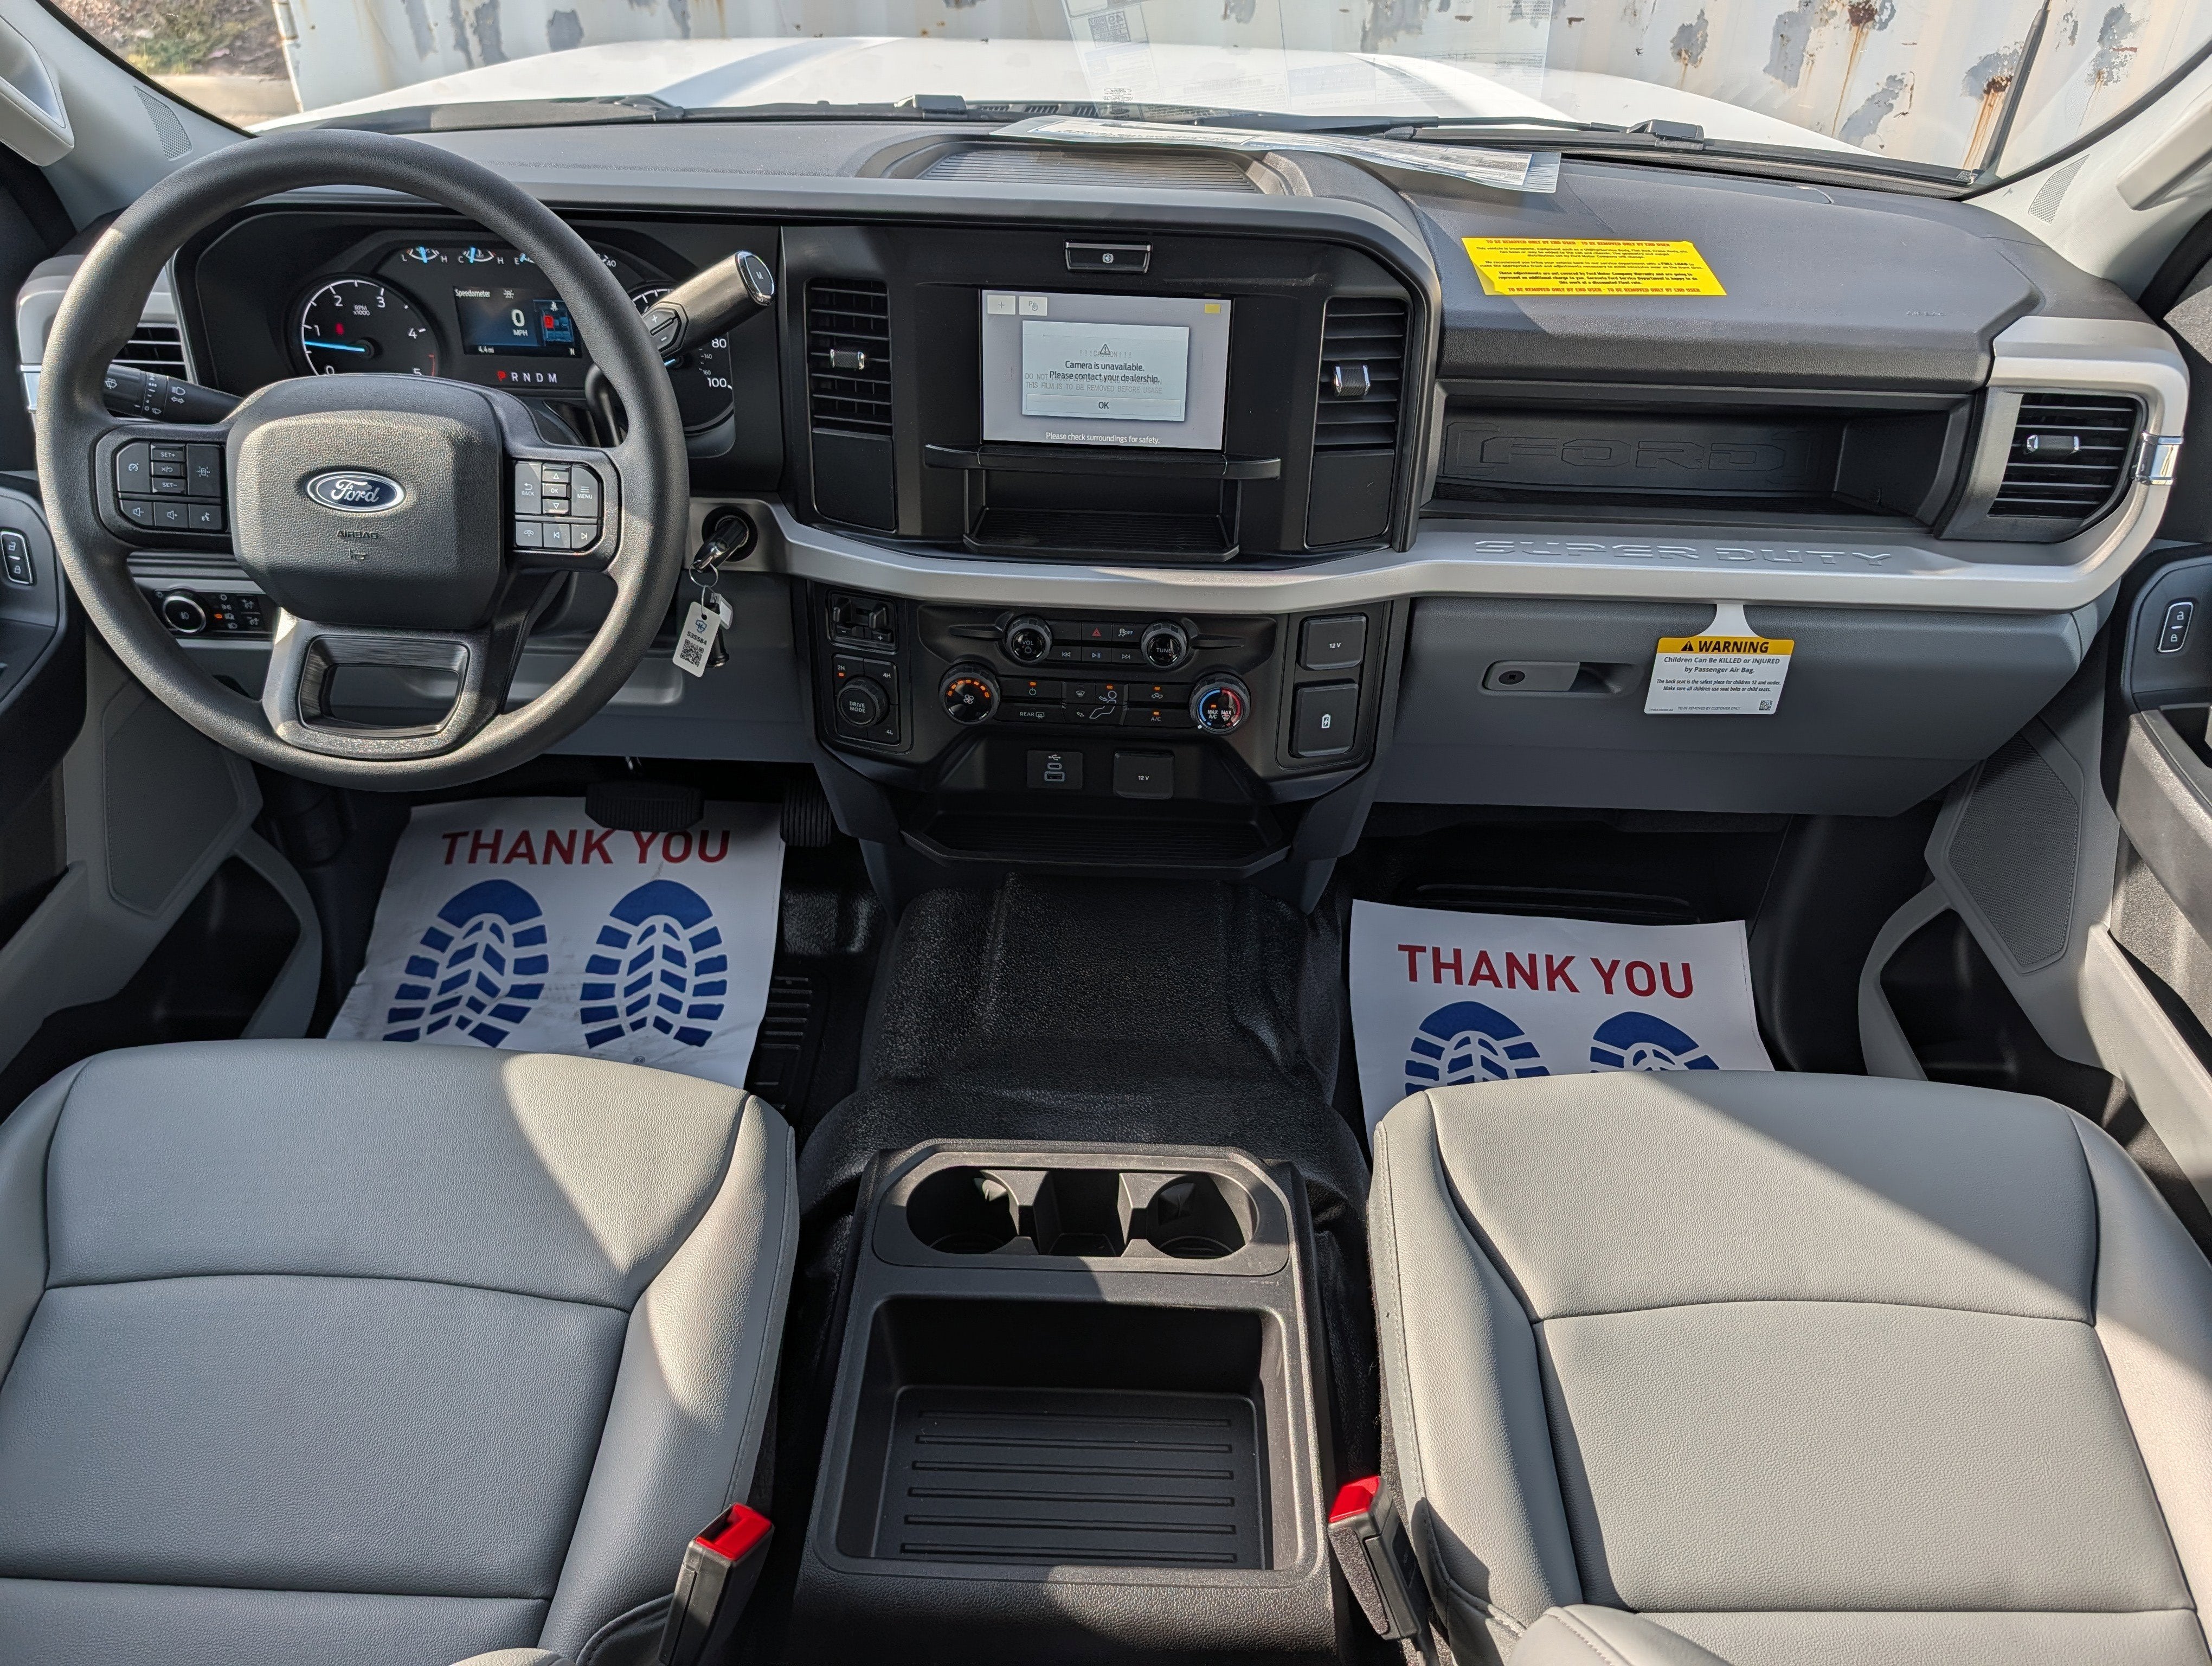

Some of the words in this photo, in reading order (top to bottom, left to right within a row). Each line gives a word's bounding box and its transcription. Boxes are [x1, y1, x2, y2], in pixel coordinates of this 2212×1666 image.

[455, 289, 491, 298] Speedometer
[334, 295, 343, 307] 2
[376, 297, 385, 308] 3
[511, 309, 525, 327] 0
[314, 325, 320, 336] 1
[408, 328, 417, 339] 4
[712, 338, 727, 348] 80
[570, 348, 575, 356] N
[325, 365, 335, 375] 0
[1065, 361, 1092, 369] Camera
[1094, 362, 1099, 370] is
[1101, 362, 1144, 371] unavailable.
[413, 368, 422, 376] 5
[497, 370, 506, 381] P
[511, 372, 518, 382] R
[523, 372, 531, 382] N
[536, 373, 543, 382] D
[548, 373, 557, 383] M
[1050, 371, 1073, 379] Please
[1075, 373, 1102, 381] contact
[1121, 375, 1160, 383] dealership.
[707, 378, 727, 388] 100
[1086, 434, 1127, 443] surroundings
[1139, 437, 1160, 445] safety.
[1481, 435, 1786, 471] FORD
[330, 480, 380, 503] Ford
[337, 530, 379, 540] AIRBAG
[1475, 540, 1701, 561] SUPER
[1714, 547, 1893, 566] DUTY
[1699, 640, 1769, 653] WARNING
[442, 828, 615, 865] THANK
[633, 829, 731, 864] YOU
[1398, 944, 1580, 994] THANK
[1590, 957, 1694, 999] YOU
